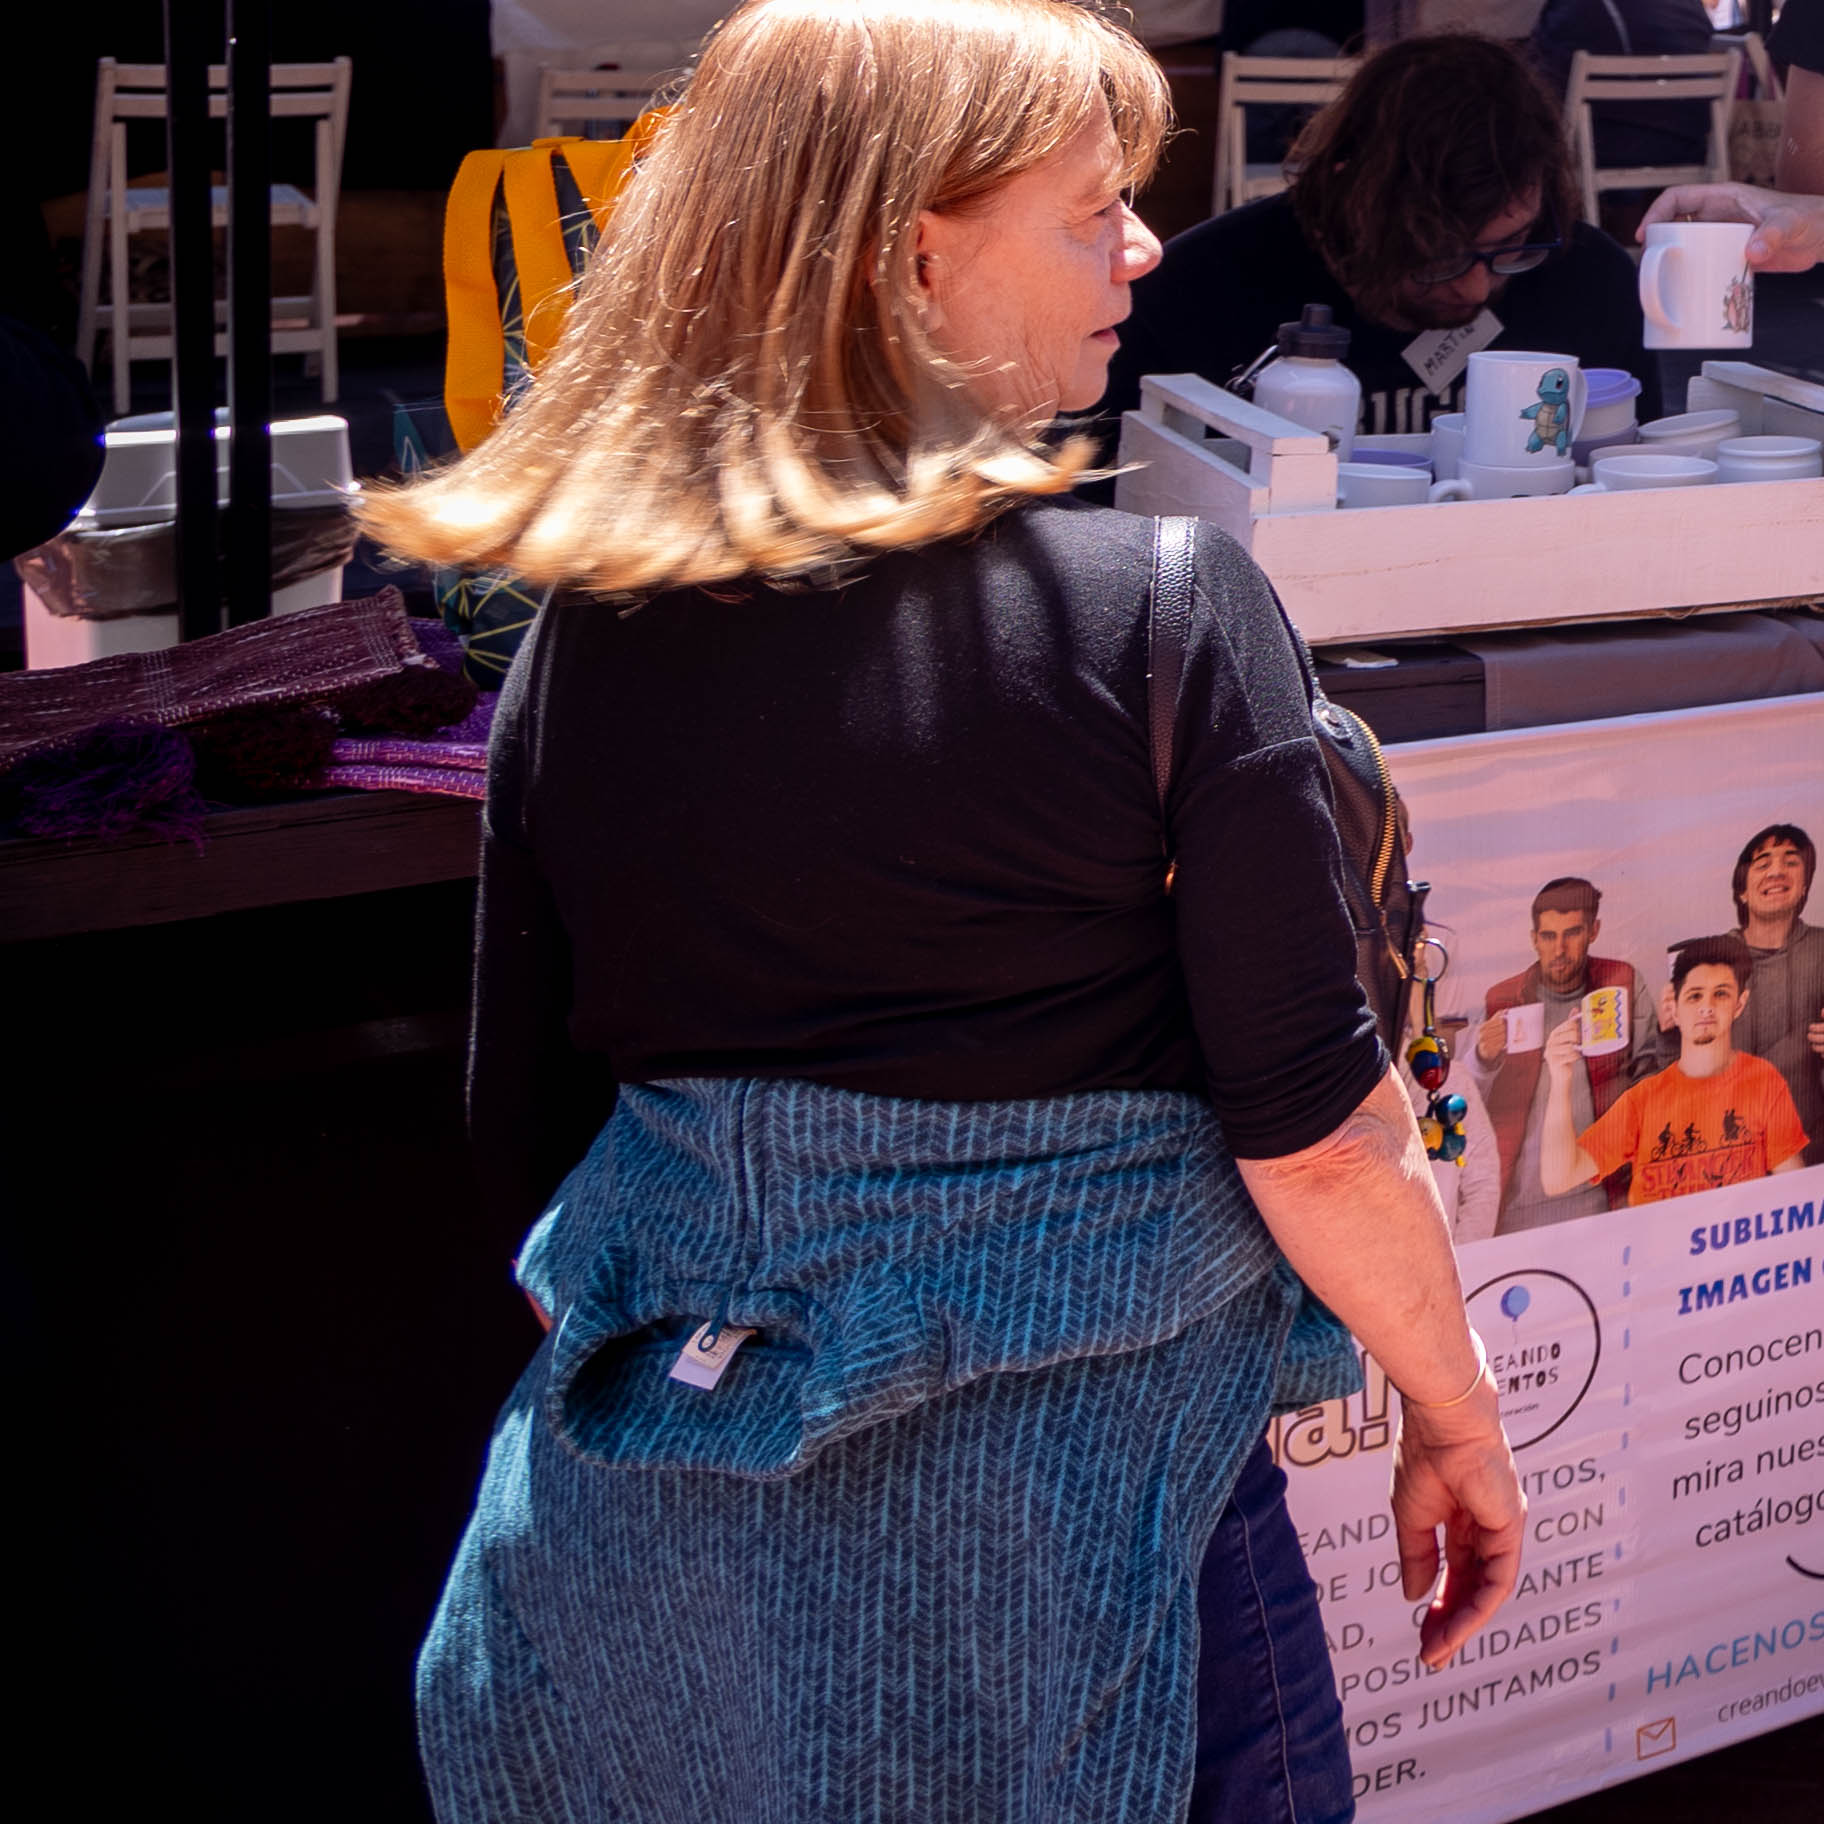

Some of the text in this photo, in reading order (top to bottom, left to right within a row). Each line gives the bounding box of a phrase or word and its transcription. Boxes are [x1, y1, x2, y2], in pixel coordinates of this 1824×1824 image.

[1677, 1257, 1812, 1316] IMAGEN
[1486, 1341, 1561, 1375] EANDO
[1496, 1365, 1560, 1398] ENTOS
[1671, 1457, 1745, 1501] mira
[1534, 1504, 1605, 1544] CON
[1340, 1601, 1602, 1702] POSILIDADES
[1416, 1650, 1602, 1731] JUNTAMOS
